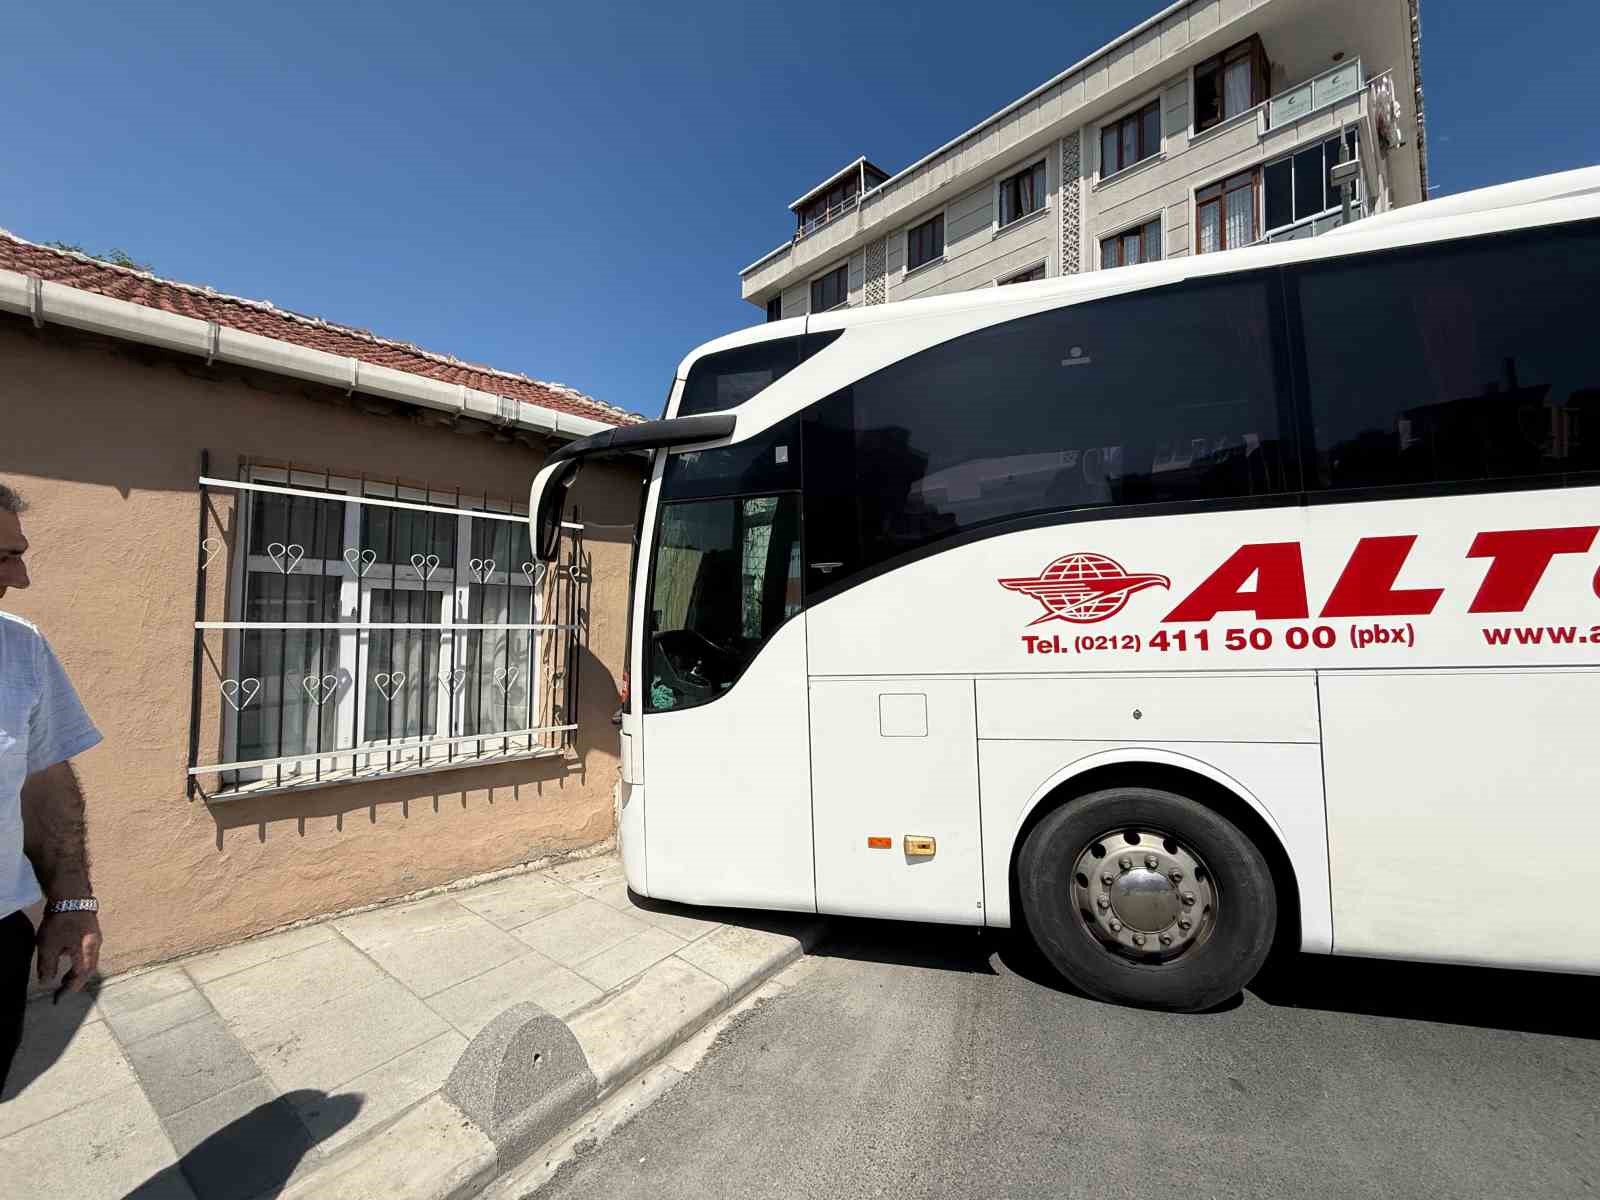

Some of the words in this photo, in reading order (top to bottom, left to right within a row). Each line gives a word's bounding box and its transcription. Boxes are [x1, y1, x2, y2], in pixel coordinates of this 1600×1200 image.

[1160, 525, 1600, 624] ALT
[1022, 635, 1068, 655] Tel.
[1074, 634, 1142, 653] (0212)
[1148, 628, 1210, 652] 411
[1225, 626, 1273, 652] 50
[1285, 625, 1336, 651] 00
[1350, 623, 1415, 648] (pbx)
